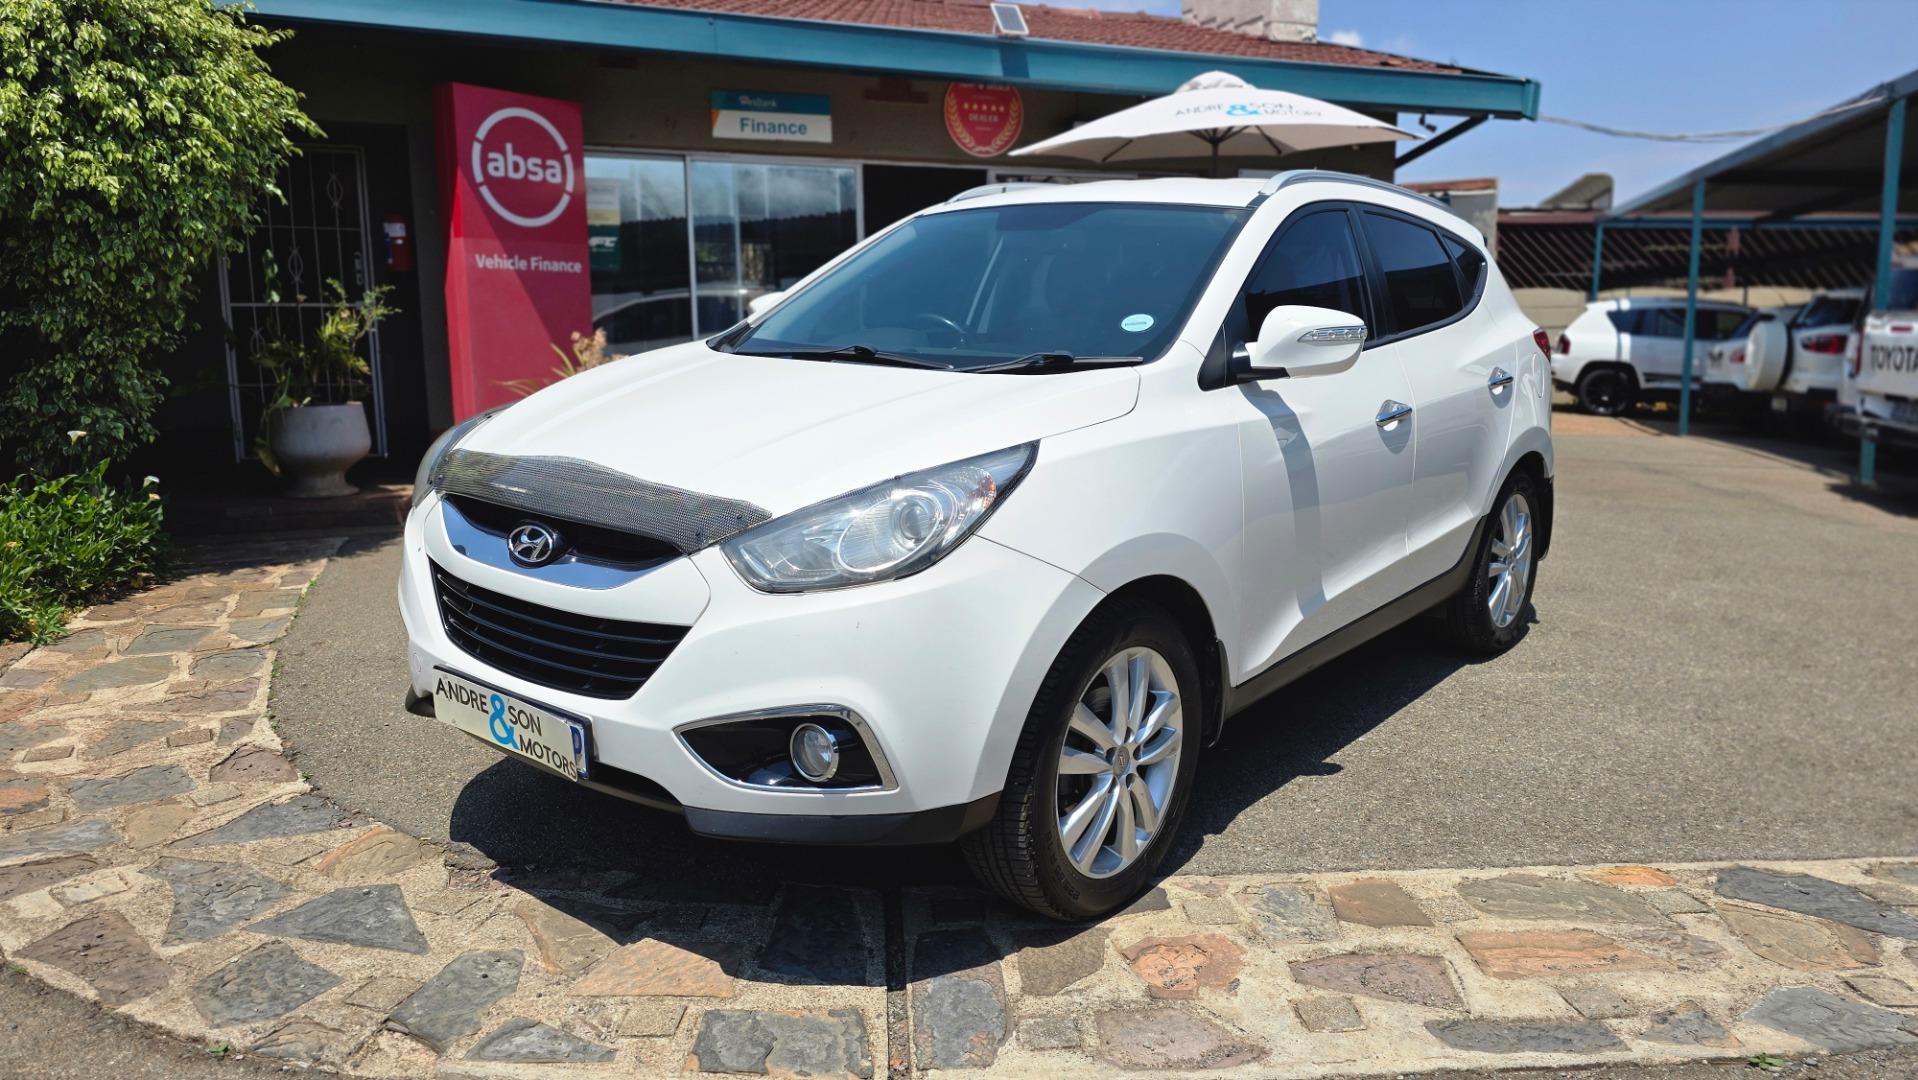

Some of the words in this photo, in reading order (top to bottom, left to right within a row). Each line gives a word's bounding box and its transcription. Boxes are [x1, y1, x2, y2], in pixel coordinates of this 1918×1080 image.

[739, 117, 808, 135] Finance
[487, 142, 562, 184] absa
[475, 254, 528, 270] Vehicle
[530, 256, 582, 273] Finance
[435, 677, 489, 715] ANDRE
[489, 693, 520, 750] &
[508, 705, 542, 737] SON
[519, 734, 577, 778] MOTORS
